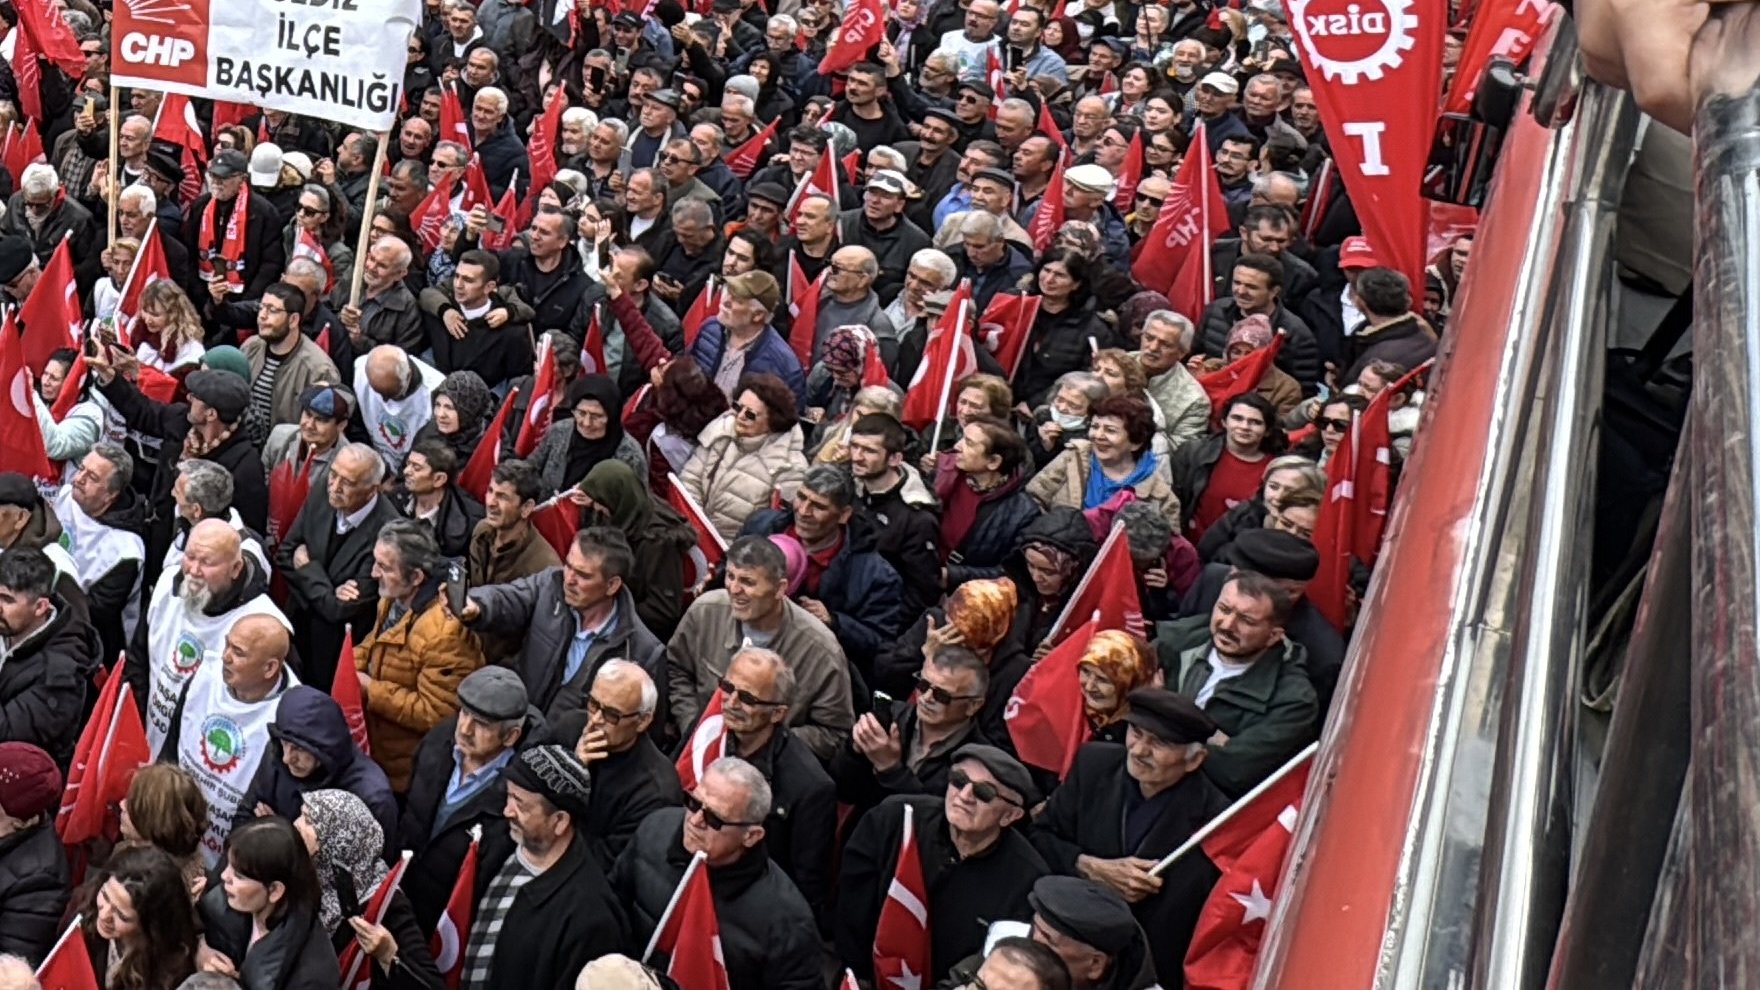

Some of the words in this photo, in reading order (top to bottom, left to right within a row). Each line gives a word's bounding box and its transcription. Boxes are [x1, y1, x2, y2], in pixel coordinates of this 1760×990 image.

[277, 13, 341, 59] İLÇE
[844, 7, 876, 43] CHP
[121, 32, 195, 67] CHP
[215, 56, 400, 114] BAŞKANLIĞI
